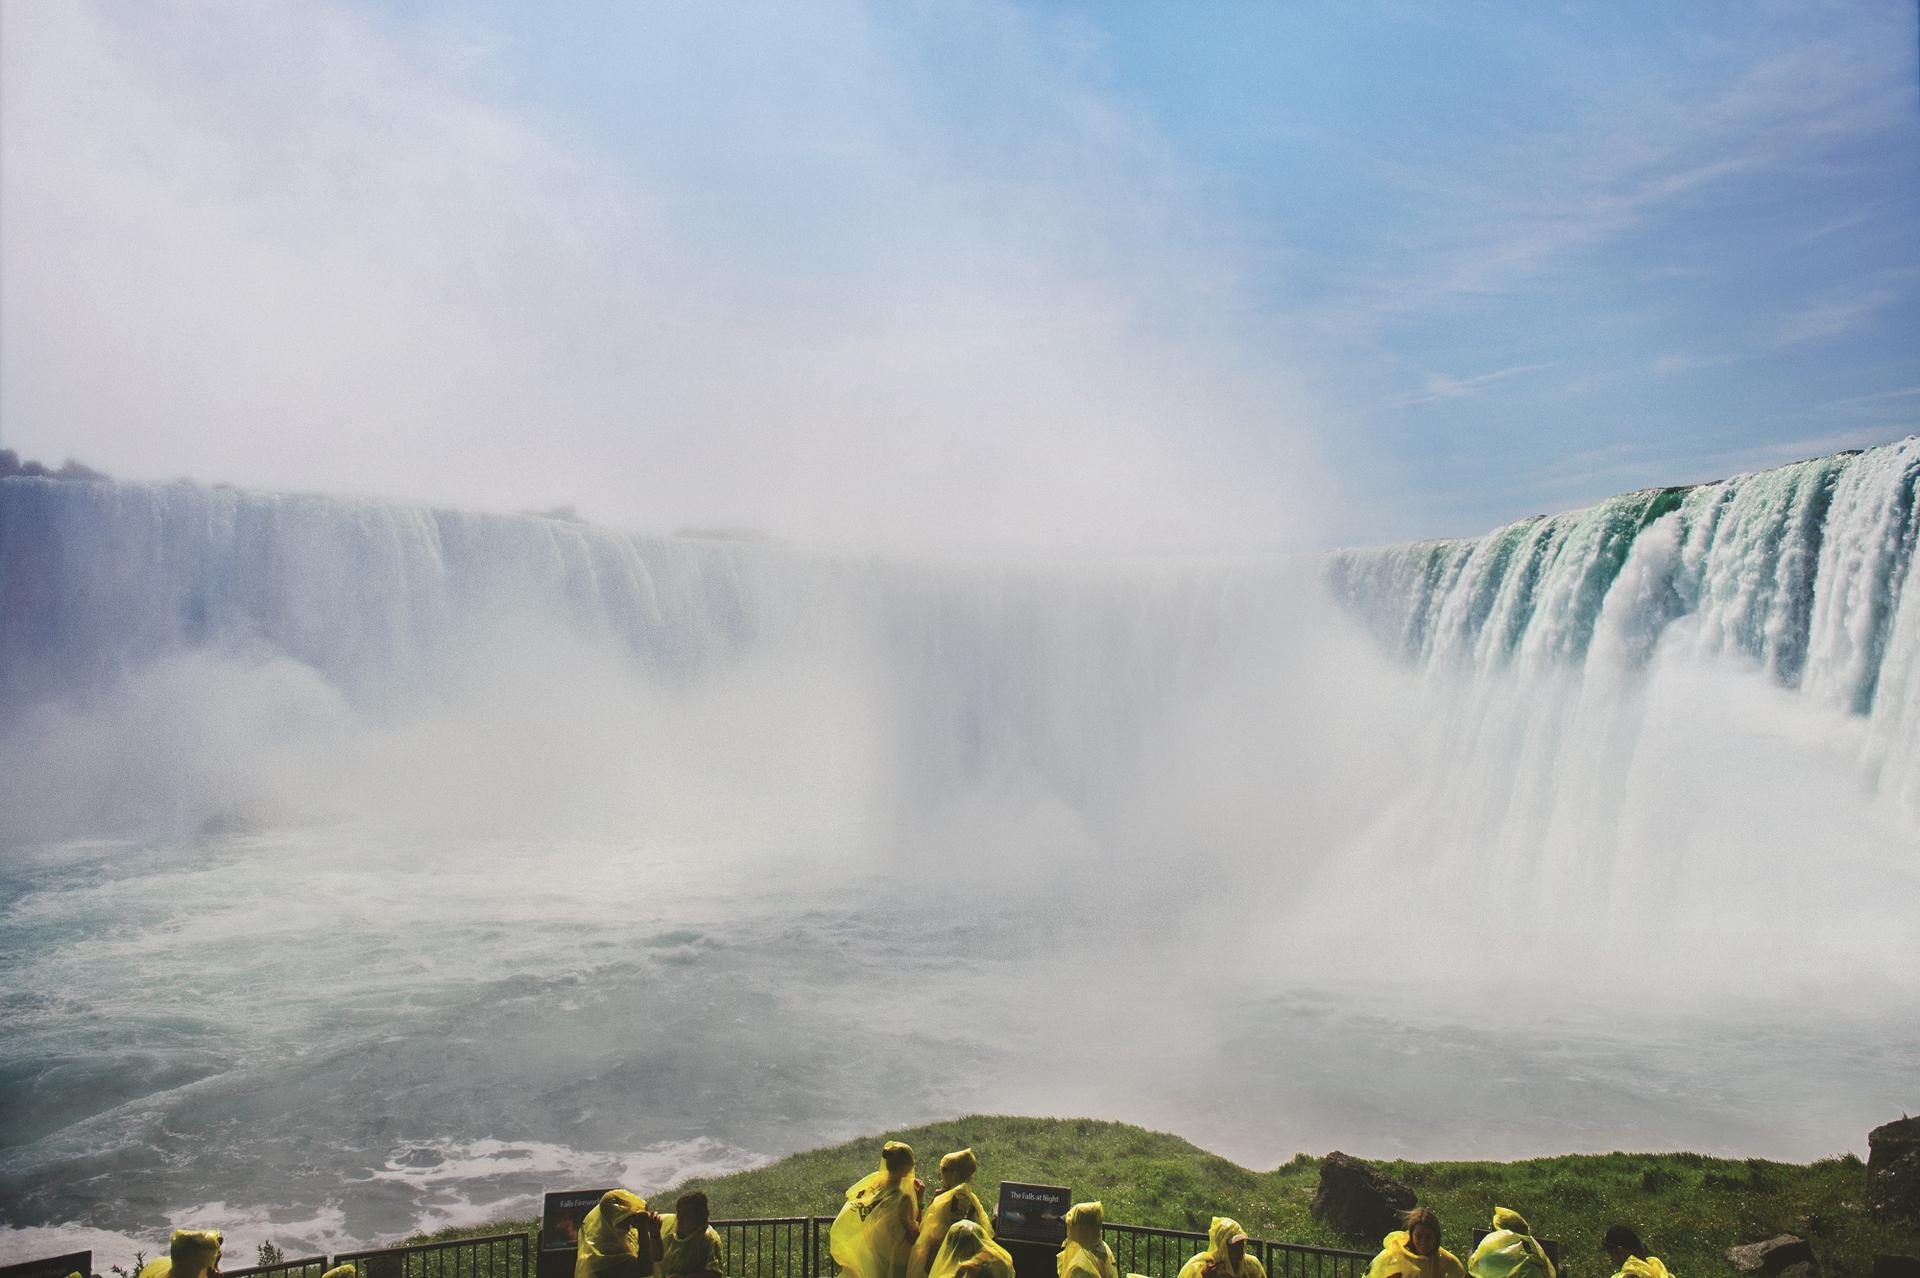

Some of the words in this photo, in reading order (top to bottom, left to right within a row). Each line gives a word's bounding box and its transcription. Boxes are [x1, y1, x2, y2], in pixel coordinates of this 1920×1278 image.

[1010, 1191, 1021, 1199] The
[1022, 1192, 1035, 1200] Falls
[1042, 1194, 1059, 1204] Night
[560, 1199, 574, 1208] Falls
